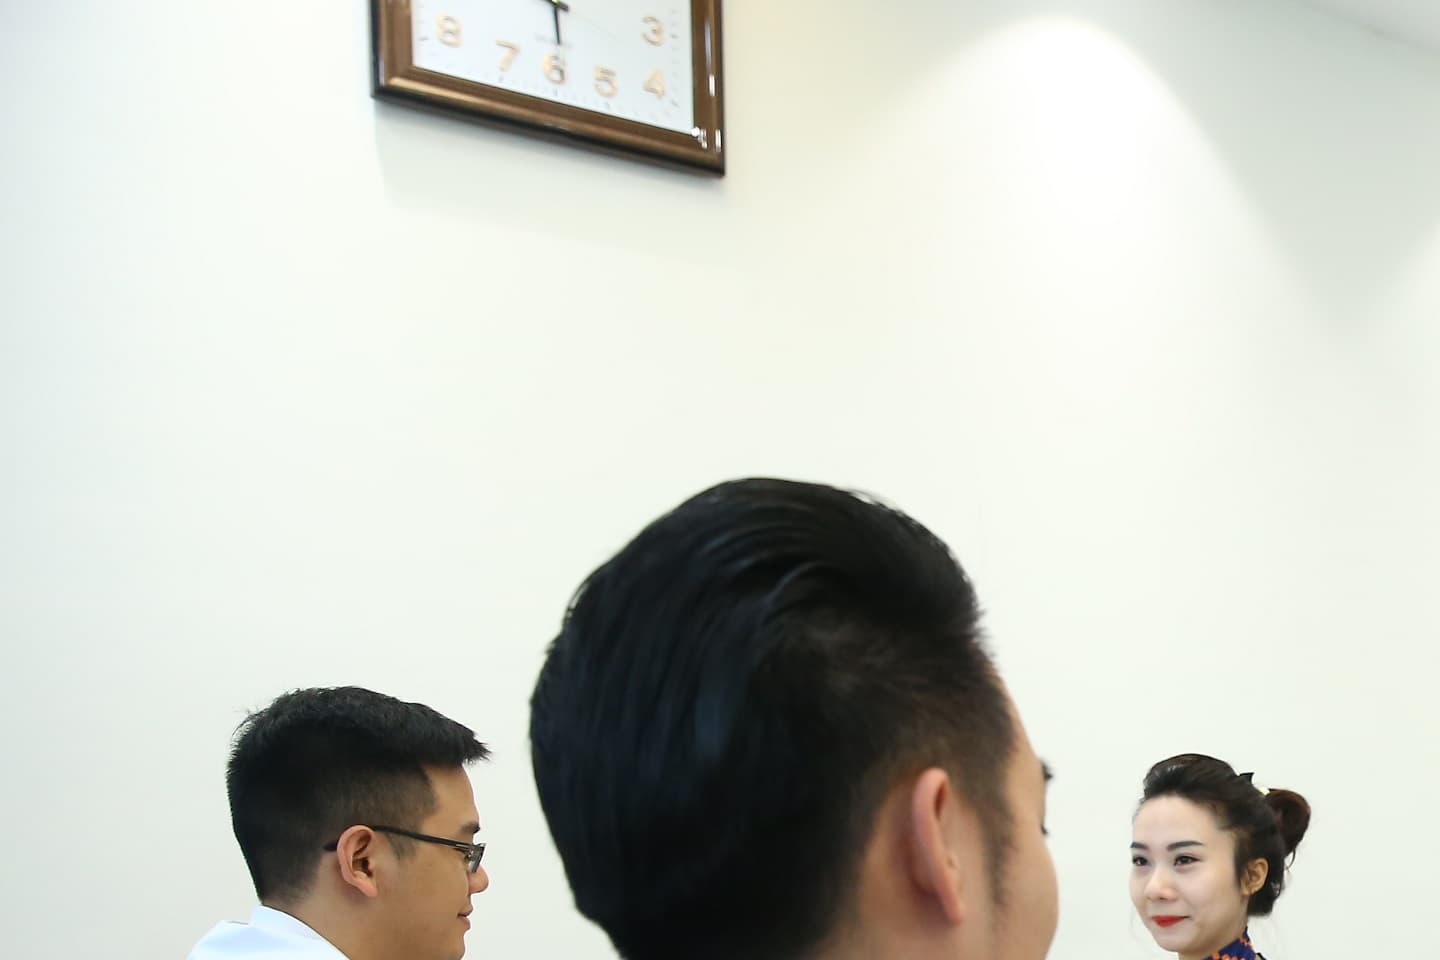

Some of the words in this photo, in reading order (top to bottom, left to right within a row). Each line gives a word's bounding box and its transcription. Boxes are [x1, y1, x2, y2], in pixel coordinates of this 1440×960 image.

[437, 15, 462, 47] 8
[641, 16, 664, 46] 3
[496, 40, 520, 72] 7
[542, 53, 566, 85] 6
[594, 66, 618, 97] 5
[643, 71, 665, 98] 4
